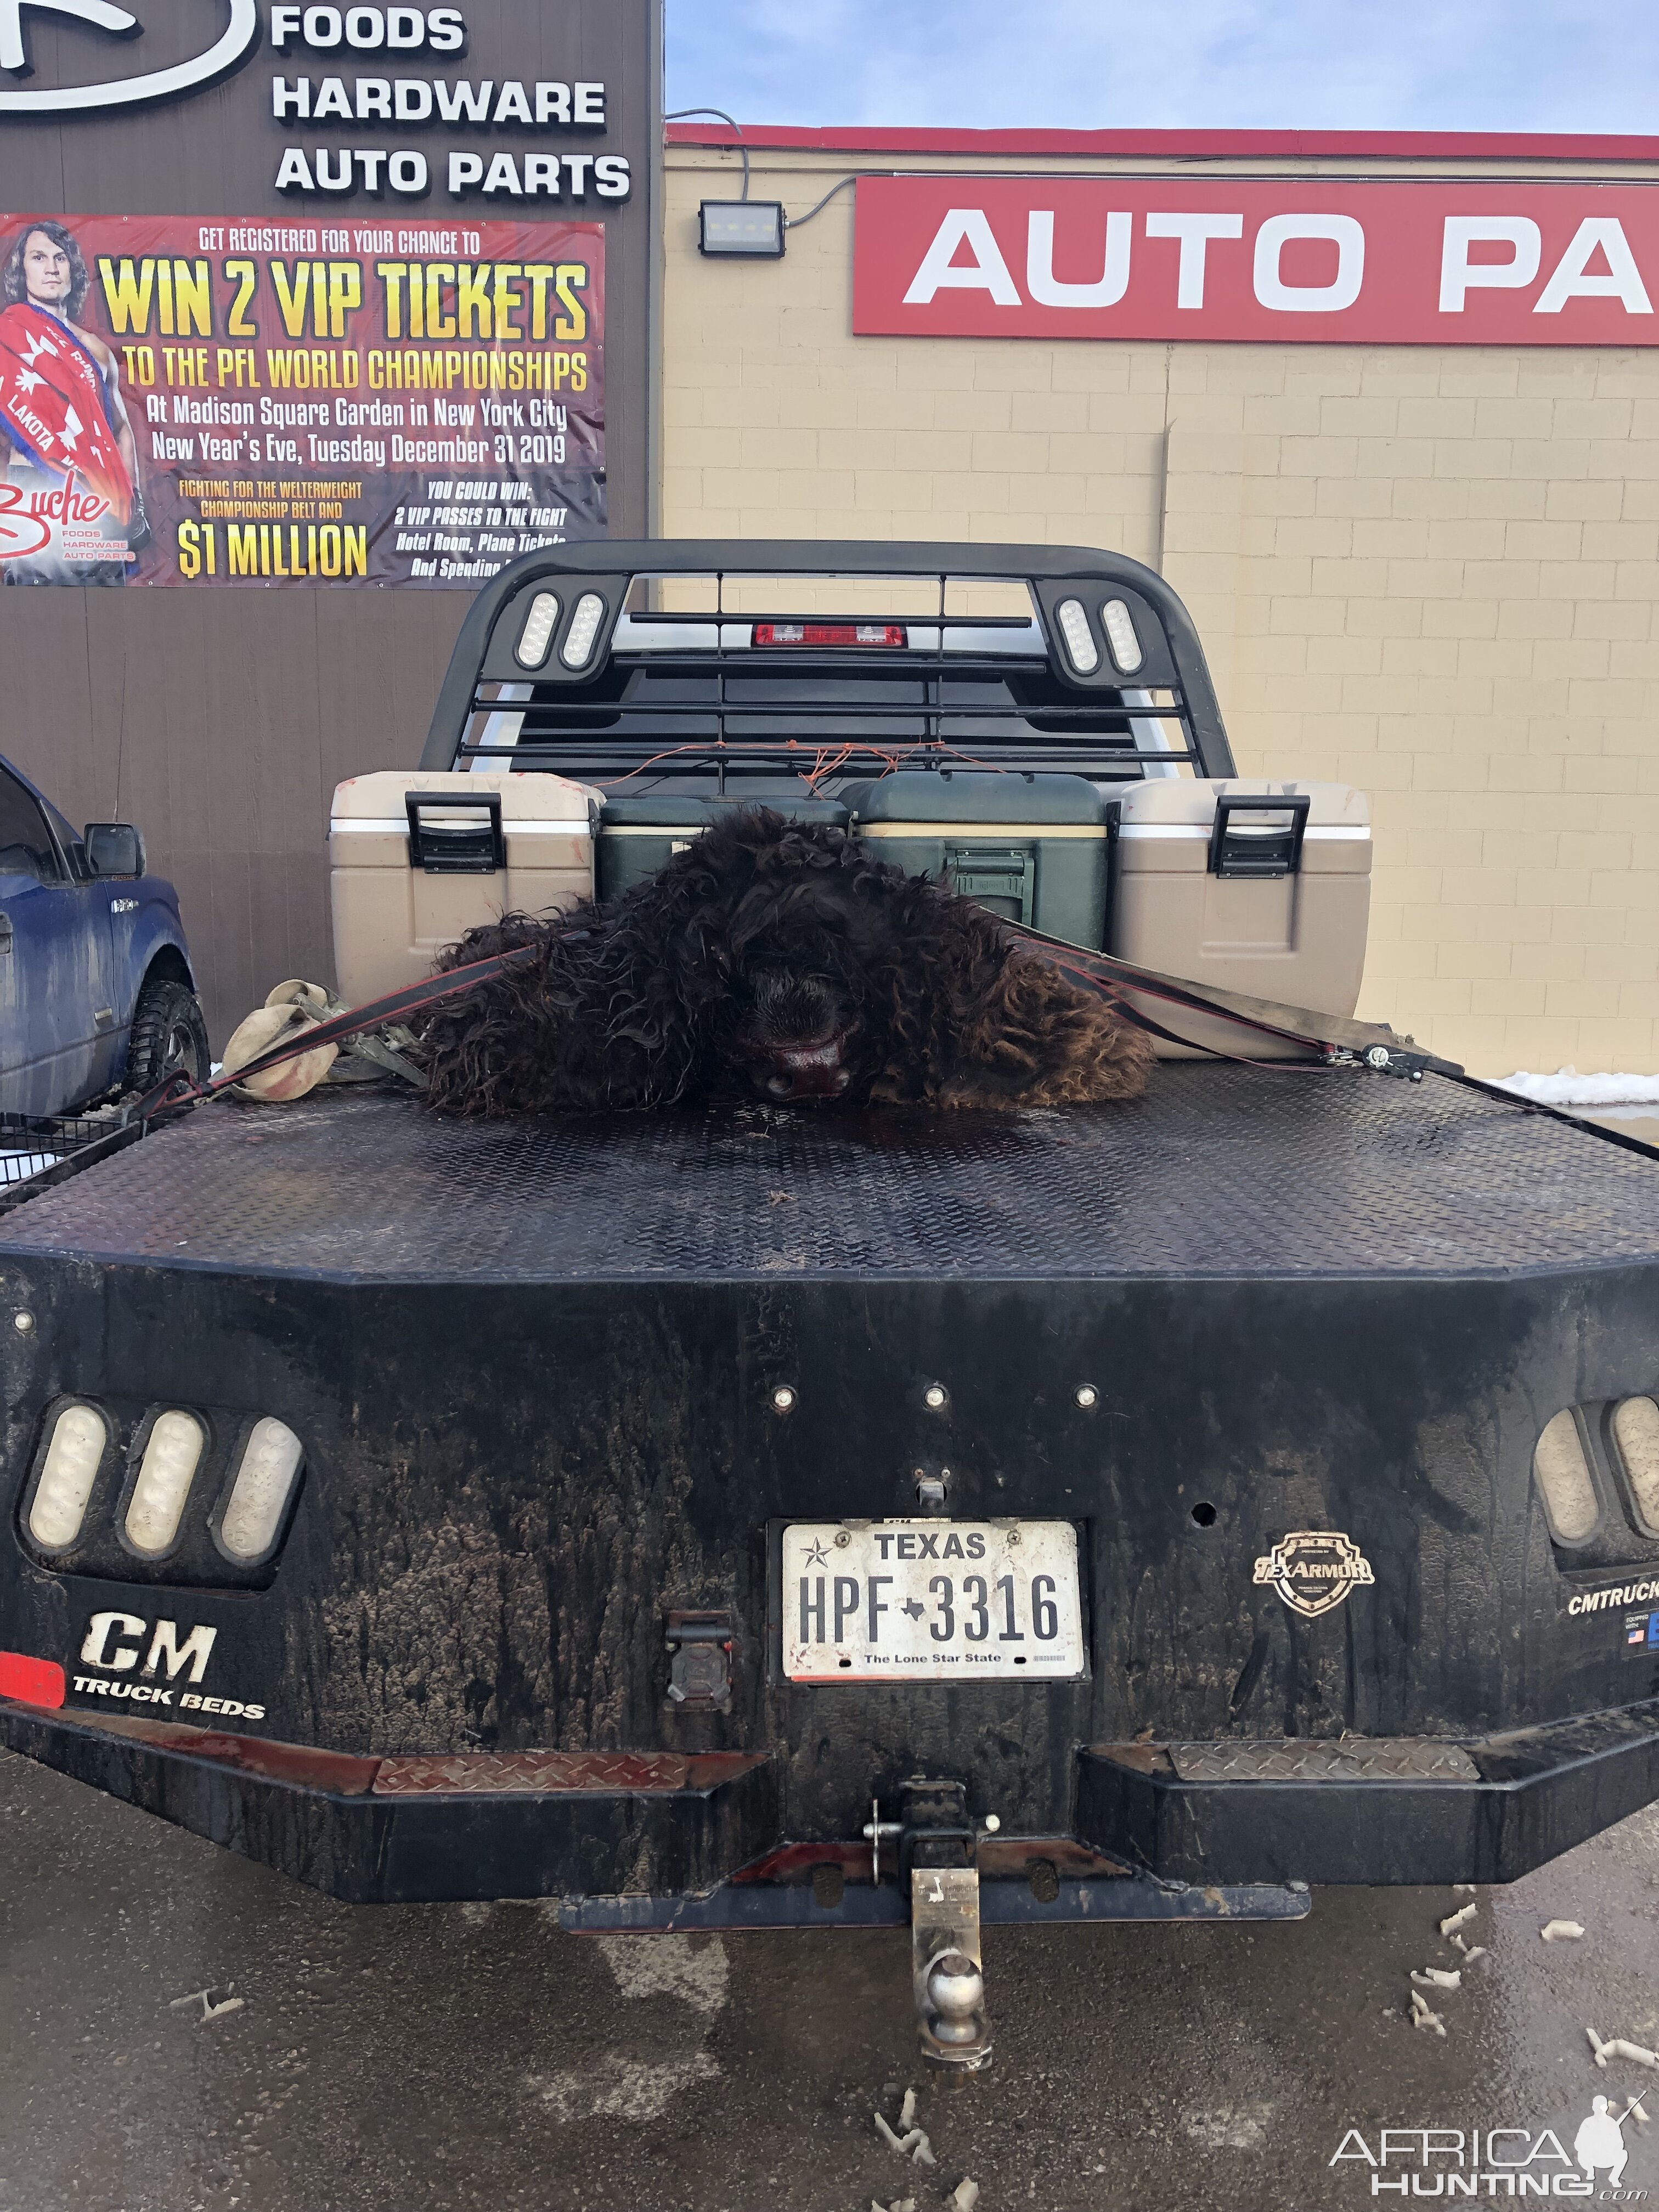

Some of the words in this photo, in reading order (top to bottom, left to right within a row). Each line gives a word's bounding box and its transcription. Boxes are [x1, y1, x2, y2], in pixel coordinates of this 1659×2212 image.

[270, 5, 466, 50] FOODS
[272, 76, 605, 123] HARDWARE
[274, 148, 428, 193] AUTO
[448, 151, 630, 197] PARTS
[199, 227, 224, 251] GET
[229, 228, 317, 252] REGISTERED
[321, 229, 350, 253] FOR
[353, 230, 394, 253] YOUR
[398, 230, 458, 255] CHANCE
[461, 231, 480, 255] TO
[902, 208, 1365, 312] AUTO
[1438, 216, 1655, 314] PA
[98, 258, 212, 336] WIN
[225, 260, 256, 336] 2
[270, 261, 361, 337] VIP
[377, 263, 586, 340] TICKETS
[122, 346, 155, 385] TO
[162, 347, 209, 387] THE
[217, 348, 261, 388] PFL
[267, 349, 359, 388] WORLD
[368, 350, 586, 391] CHAMPIONSHIPS
[7, 394, 55, 452] LAKOTA
[146, 394, 167, 422] At
[173, 395, 254, 425] Madison
[260, 397, 329, 430] Square
[335, 397, 404, 426] Garden
[410, 398, 428, 426] in
[434, 398, 476, 426] New
[479, 398, 524, 427] York
[529, 398, 567, 432] City
[152, 431, 194, 460] New
[198, 431, 261, 462] Year's
[266, 433, 302, 465] Eve,
[307, 434, 385, 467] Tuesday
[391, 434, 489, 462] December
[495, 435, 514, 462] 31
[520, 435, 566, 463] 2019
[179, 479, 229, 498] FIGHTING
[233, 481, 254, 498] FOR
[257, 481, 276, 498] THE
[279, 481, 362, 499] WELTERWEIGHT
[201, 500, 289, 518] CHAMPIONSHIP
[291, 502, 315, 518] BELT
[319, 502, 342, 518] AND
[428, 481, 453, 500] YOU
[455, 481, 498, 500] COULD
[500, 482, 533, 500] WIN:
[394, 507, 405, 525] 2
[408, 507, 431, 525] VIP
[432, 507, 483, 526] PASSES
[486, 507, 503, 526] TO
[505, 507, 528, 526] THE
[529, 508, 567, 526] FIGHT
[178, 518, 216, 579] $1
[227, 523, 368, 576] MILLION
[396, 532, 430, 551] Hotel
[433, 533, 473, 554] Room,
[478, 533, 515, 551] Plane
[411, 558, 438, 577] And
[439, 559, 501, 579] Spending
[874, 1533, 986, 1559] TEXAS
[800, 1576, 893, 1643] HPF
[929, 1575, 1058, 1641] 3316
[81, 1612, 217, 1683] CM
[865, 1654, 890, 1663] The
[895, 1654, 927, 1663] Lone
[933, 1654, 961, 1663] Star
[966, 1653, 1001, 1663] State
[73, 1676, 174, 1705] TRUCK
[179, 1693, 266, 1719] BEDS
